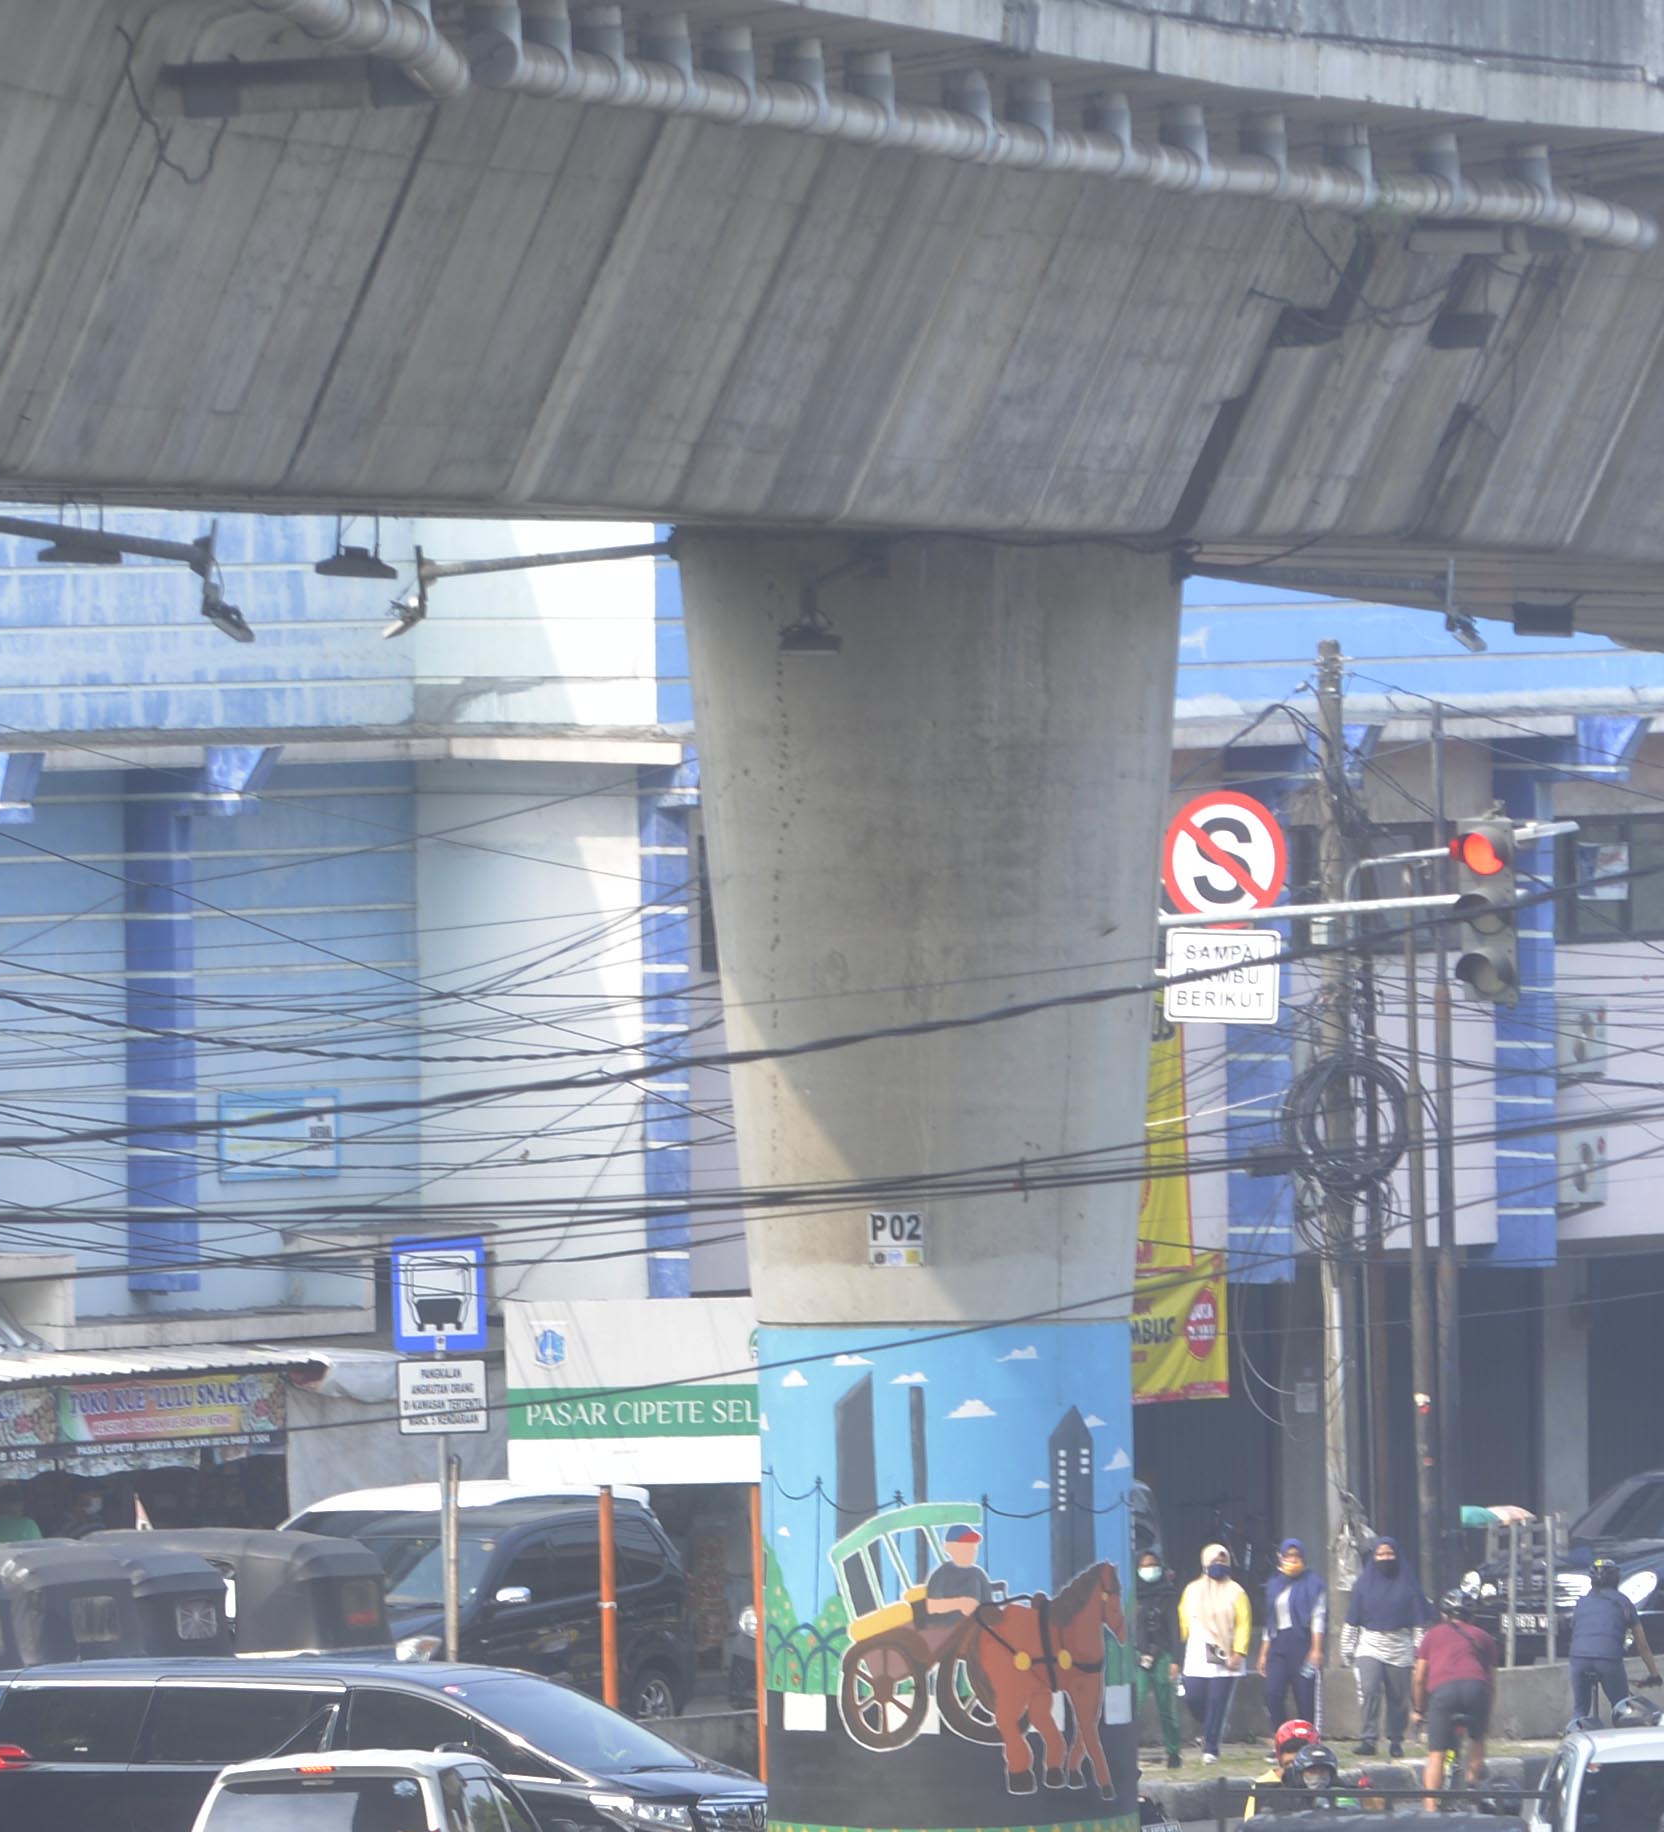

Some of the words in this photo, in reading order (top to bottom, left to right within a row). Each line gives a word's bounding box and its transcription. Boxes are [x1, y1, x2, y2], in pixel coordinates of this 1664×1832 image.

[1177, 990, 1264, 1008] BERIKUT
[871, 1214, 923, 1242] P02
[70, 1391, 109, 1415] TOKO
[113, 1386, 146, 1413] KUE
[527, 1402, 607, 1427] PASAR
[614, 1400, 705, 1425] CIPETE
[105, 1442, 134, 1454] CIPETE
